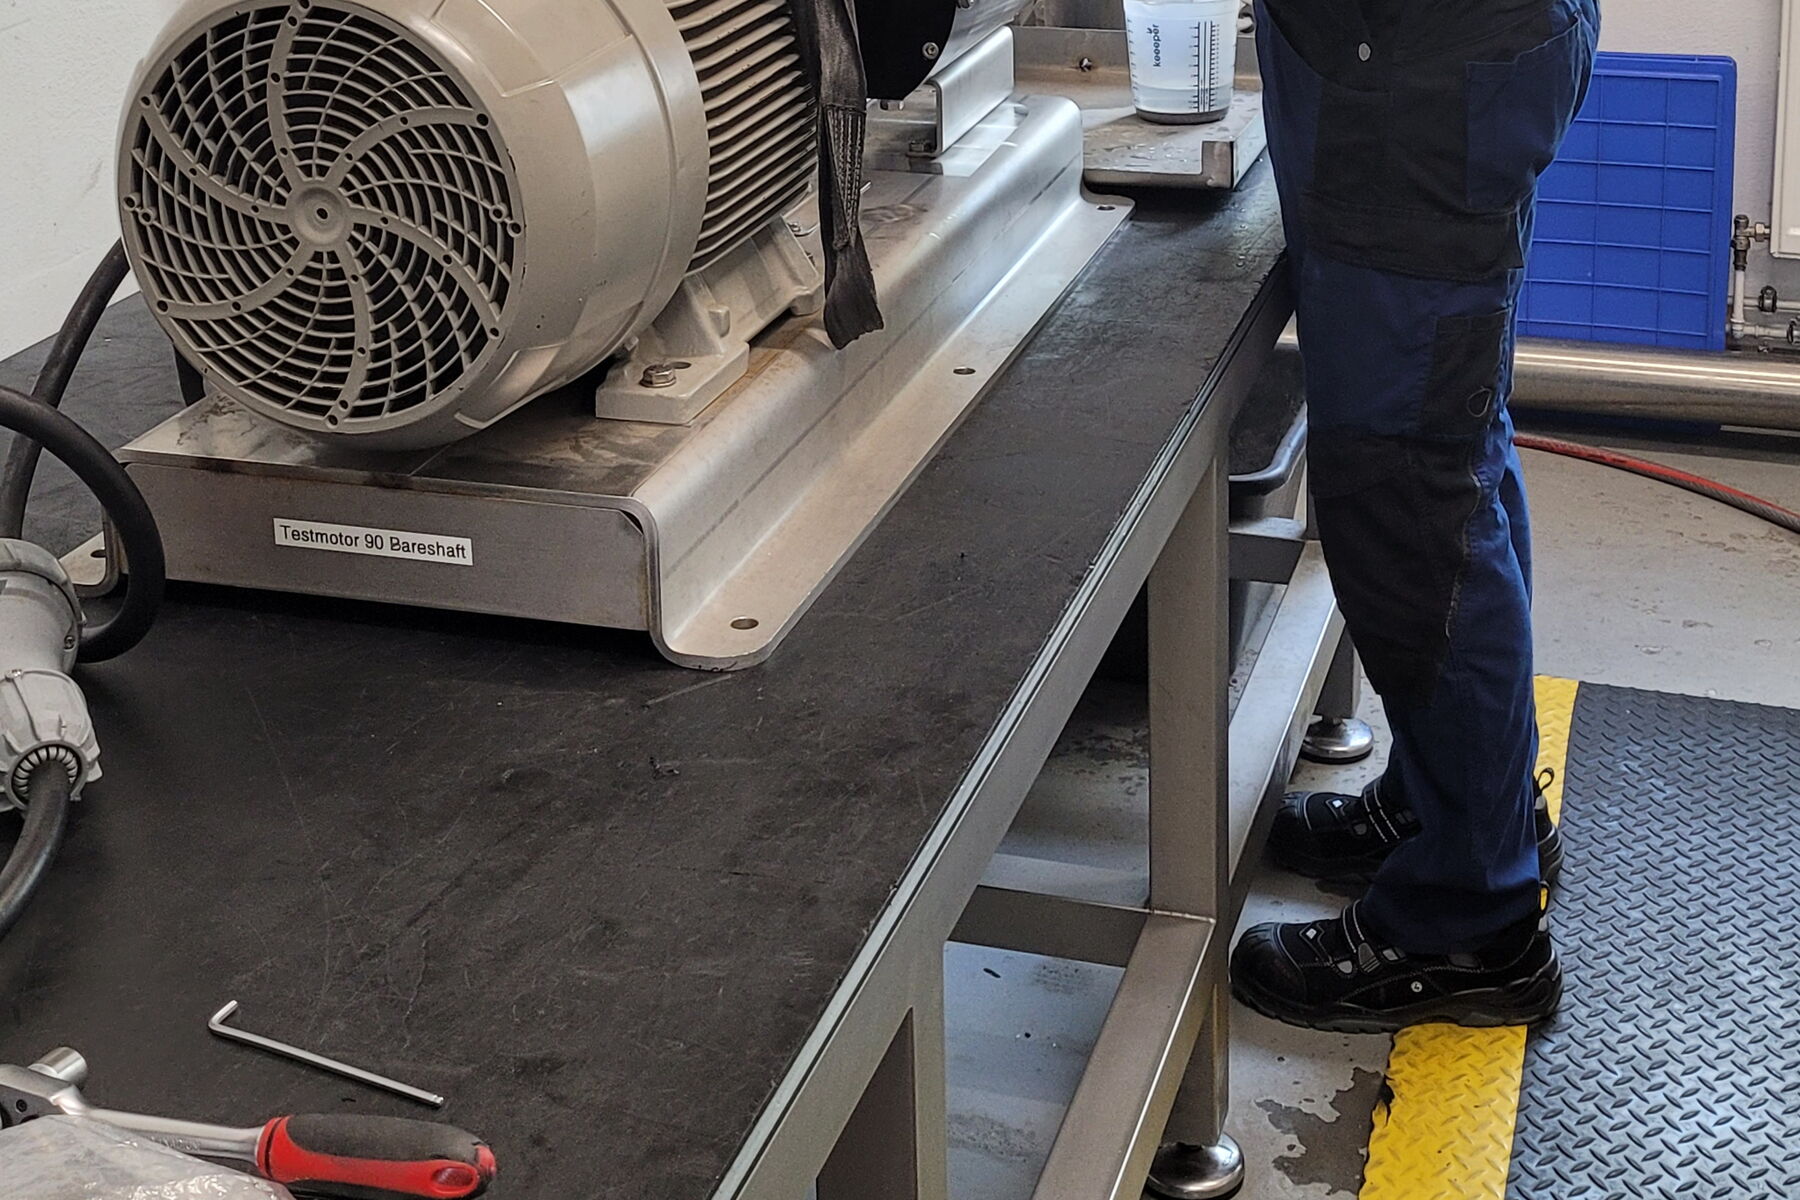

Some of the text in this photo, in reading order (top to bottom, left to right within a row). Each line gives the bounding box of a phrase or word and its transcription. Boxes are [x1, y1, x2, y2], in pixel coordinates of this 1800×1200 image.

[280, 525, 466, 559] Testmotor 90 Bareshaft
